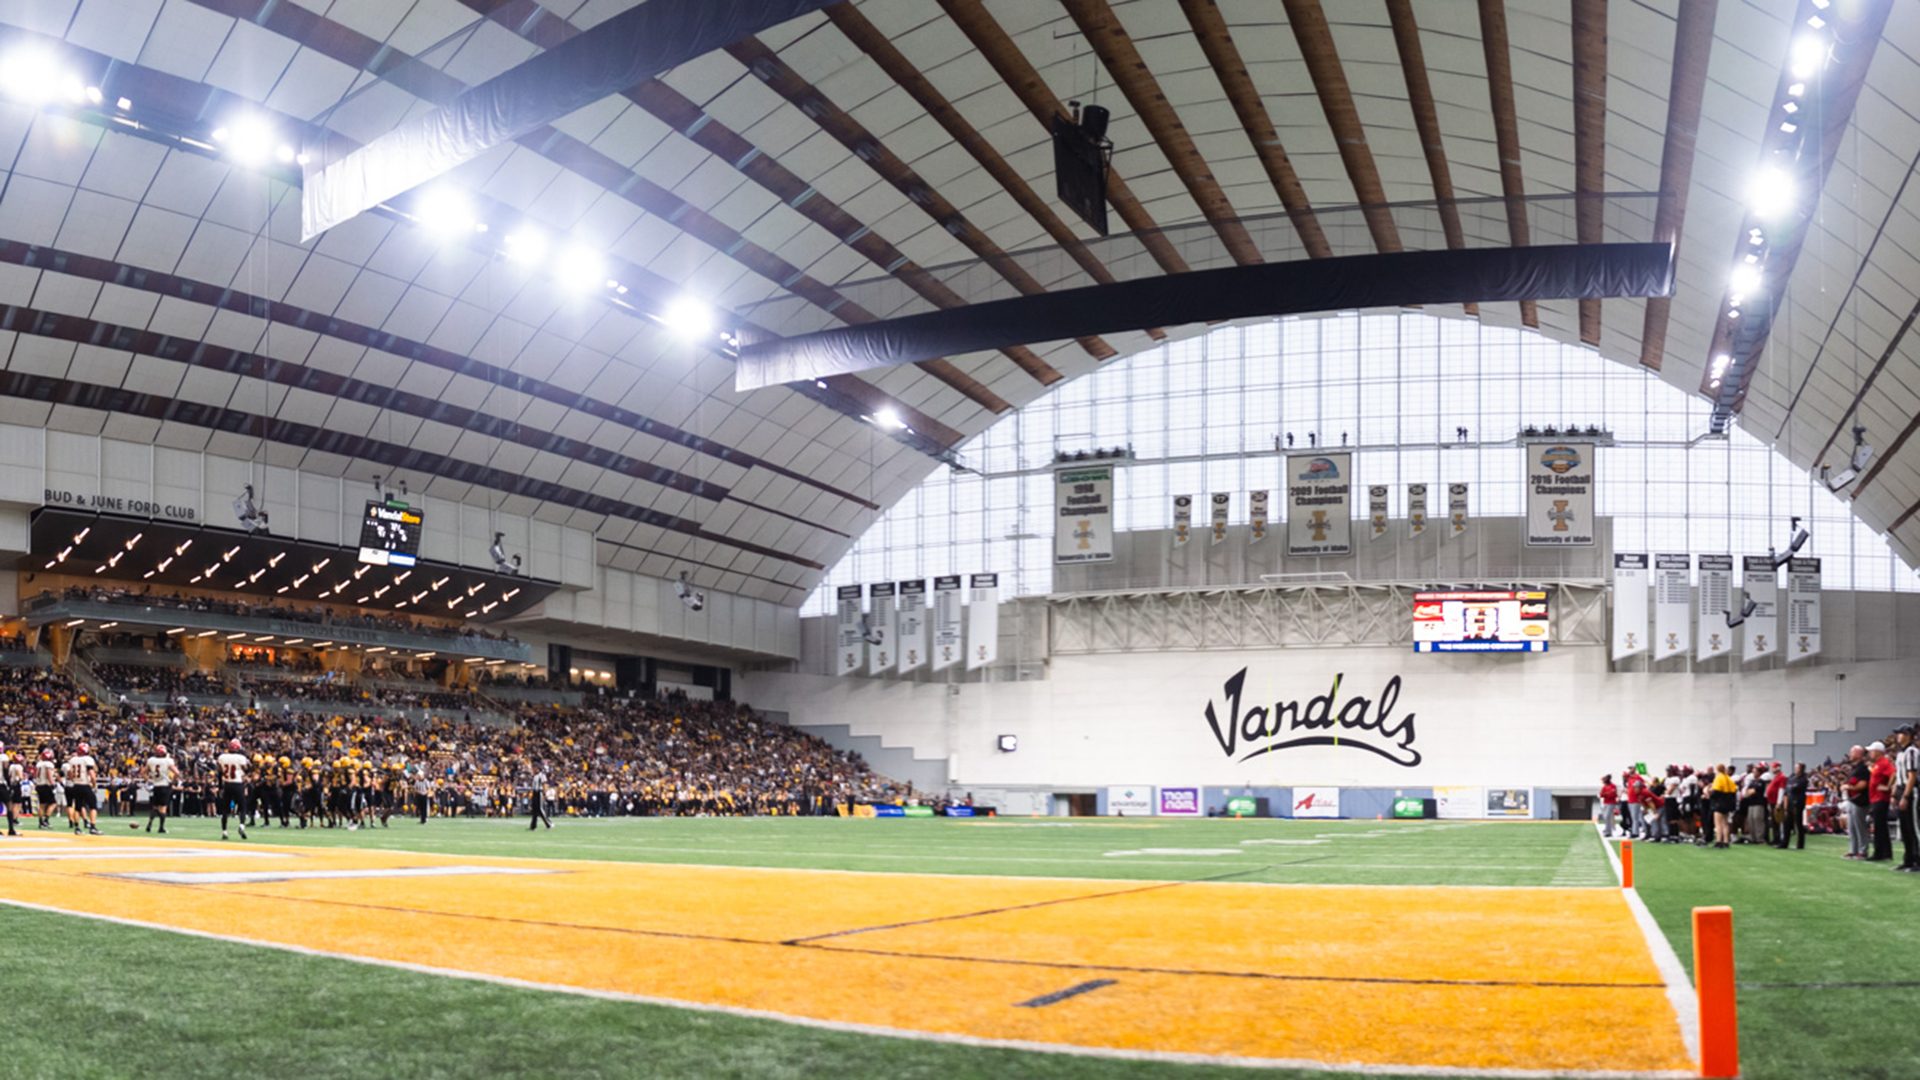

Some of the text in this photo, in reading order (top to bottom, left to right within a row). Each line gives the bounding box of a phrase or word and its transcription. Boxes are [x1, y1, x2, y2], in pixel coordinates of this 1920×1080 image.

[1530, 474, 1590, 485] 2016 Football
[1290, 484, 1349, 496] 2009 Football
[1535, 485, 1586, 496] Champions
[45, 489, 195, 519] BUD & JUNE FORD CLUB
[1066, 494, 1101, 505] Football
[1295, 495, 1343, 506] Champions
[1060, 505, 1109, 517] Champions
[1529, 535, 1592, 543] University of Idaho
[1205, 666, 1421, 767] Vandals
